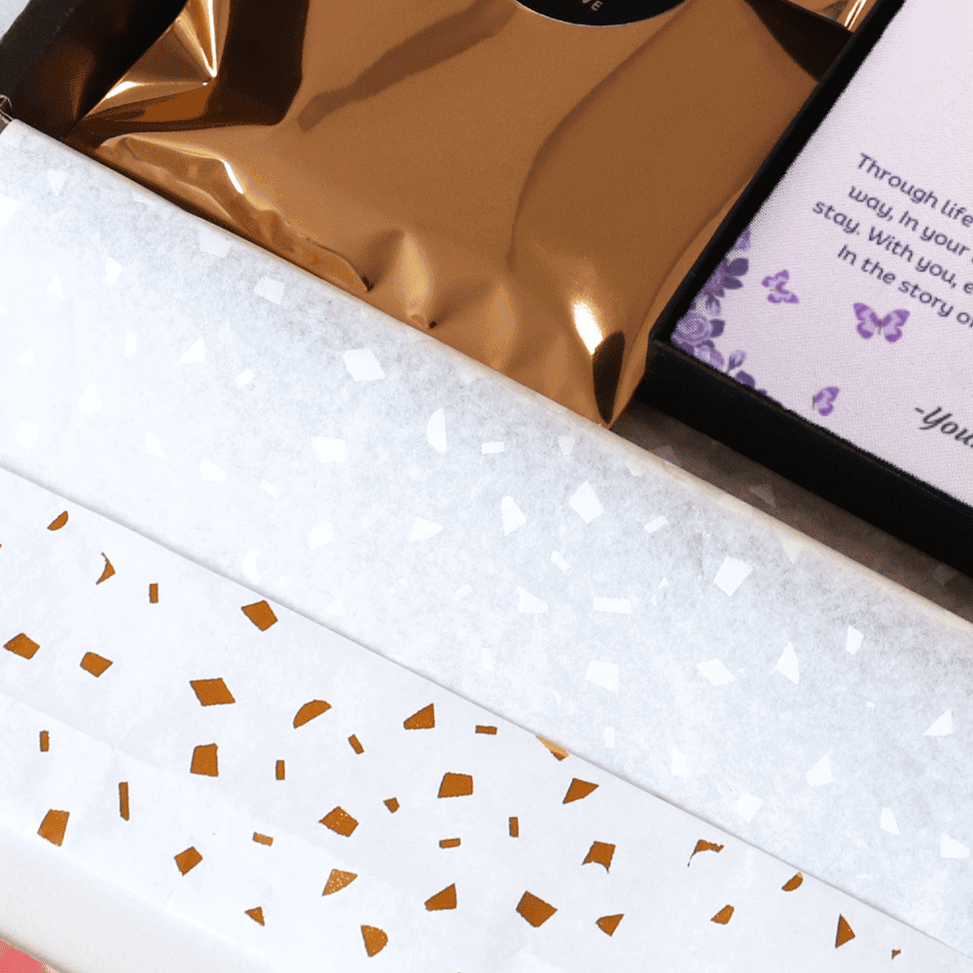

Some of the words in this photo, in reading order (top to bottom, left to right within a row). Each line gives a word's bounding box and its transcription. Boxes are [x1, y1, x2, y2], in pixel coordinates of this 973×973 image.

[857, 152, 939, 209] Through
[812, 200, 861, 236] stay.
[868, 226, 915, 263] With
[915, 256, 957, 289] you,
[848, 185, 893, 222] way,
[898, 211, 919, 232] In
[919, 225, 970, 257] your
[837, 244, 857, 266] In
[861, 259, 896, 285] the
[898, 279, 954, 318] story
